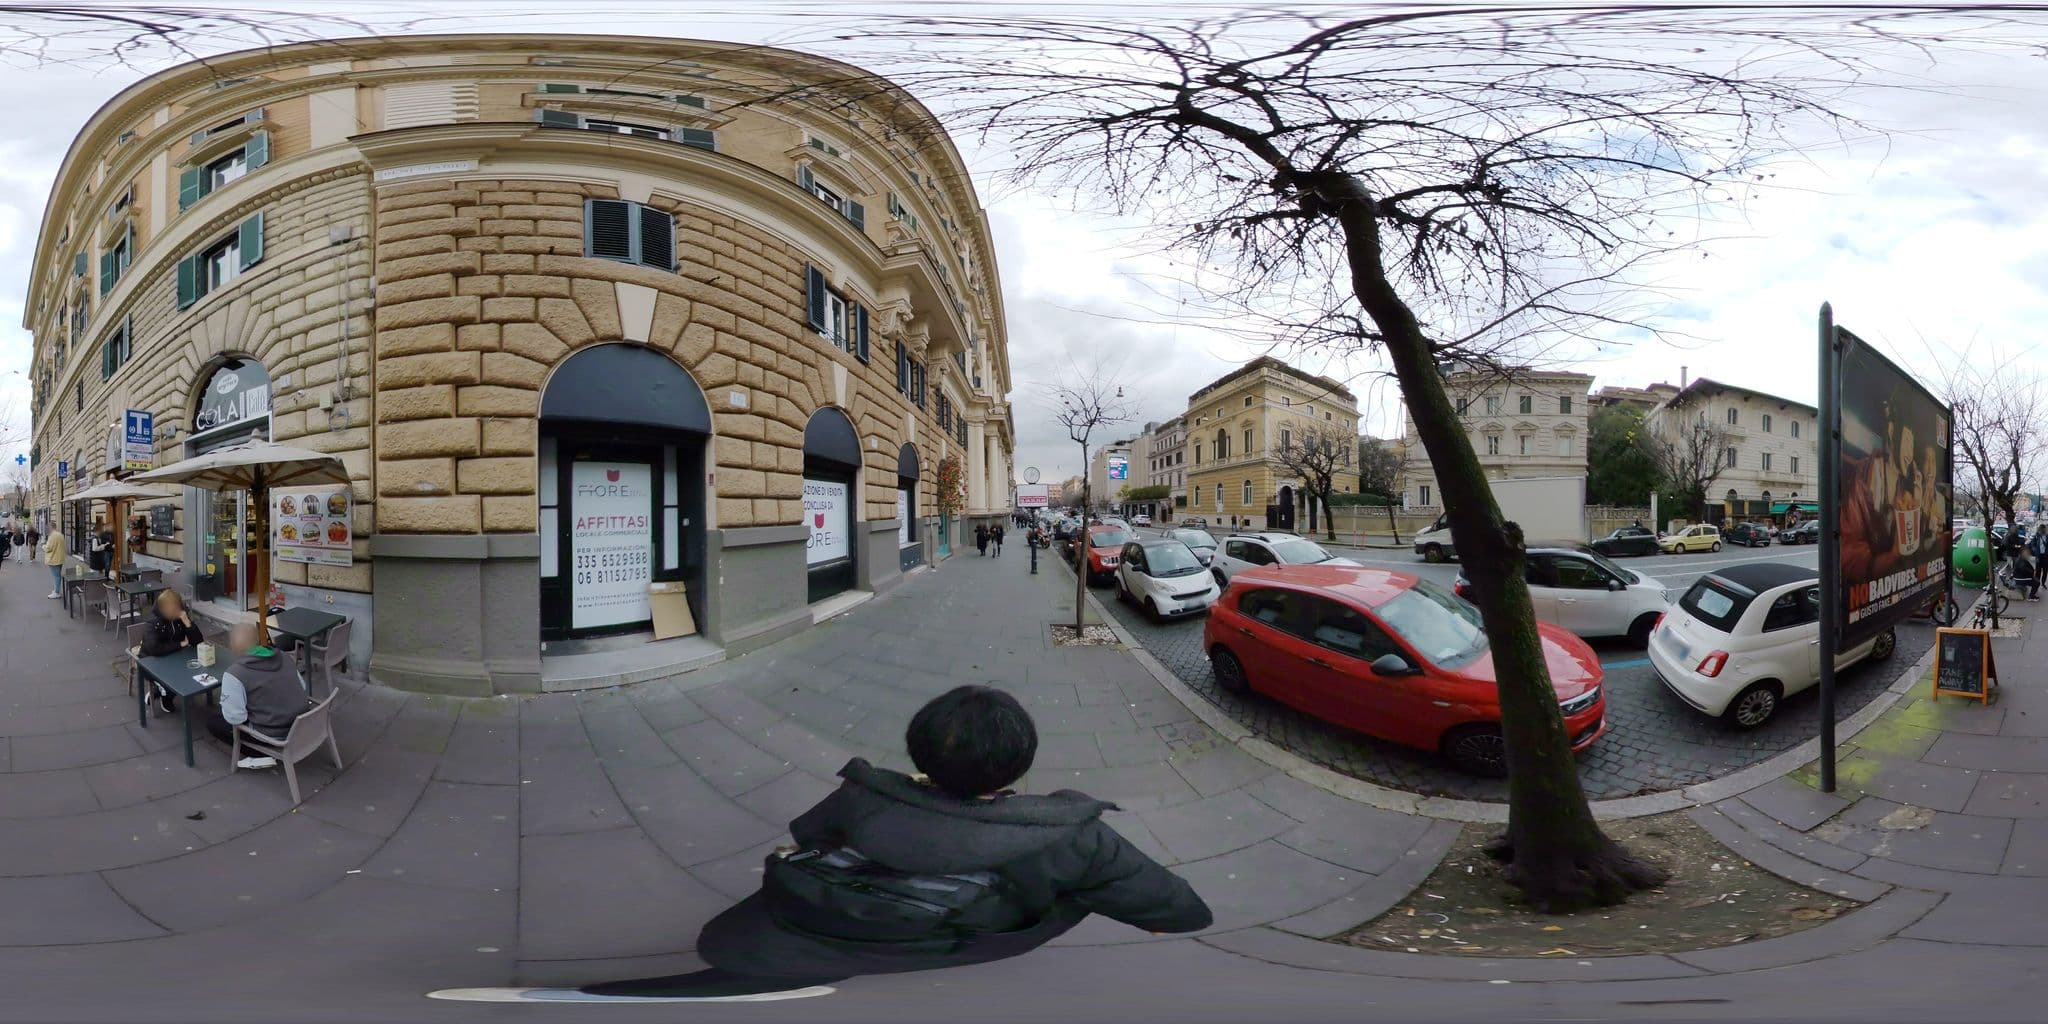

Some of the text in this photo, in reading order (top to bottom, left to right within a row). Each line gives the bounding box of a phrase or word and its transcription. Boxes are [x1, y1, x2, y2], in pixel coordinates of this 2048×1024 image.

[130, 412, 149, 434] T
[197, 400, 239, 430] COLA
[578, 485, 631, 497] FIORE
[576, 516, 648, 530] AFFITTASI
[603, 529, 648, 537] COMMERCIALE
[593, 544, 648, 553] INFORMAZIONI
[577, 552, 648, 569] 335 6529588
[578, 567, 648, 585] 06 81152795
[1860, 602, 1879, 619] GUSTO
